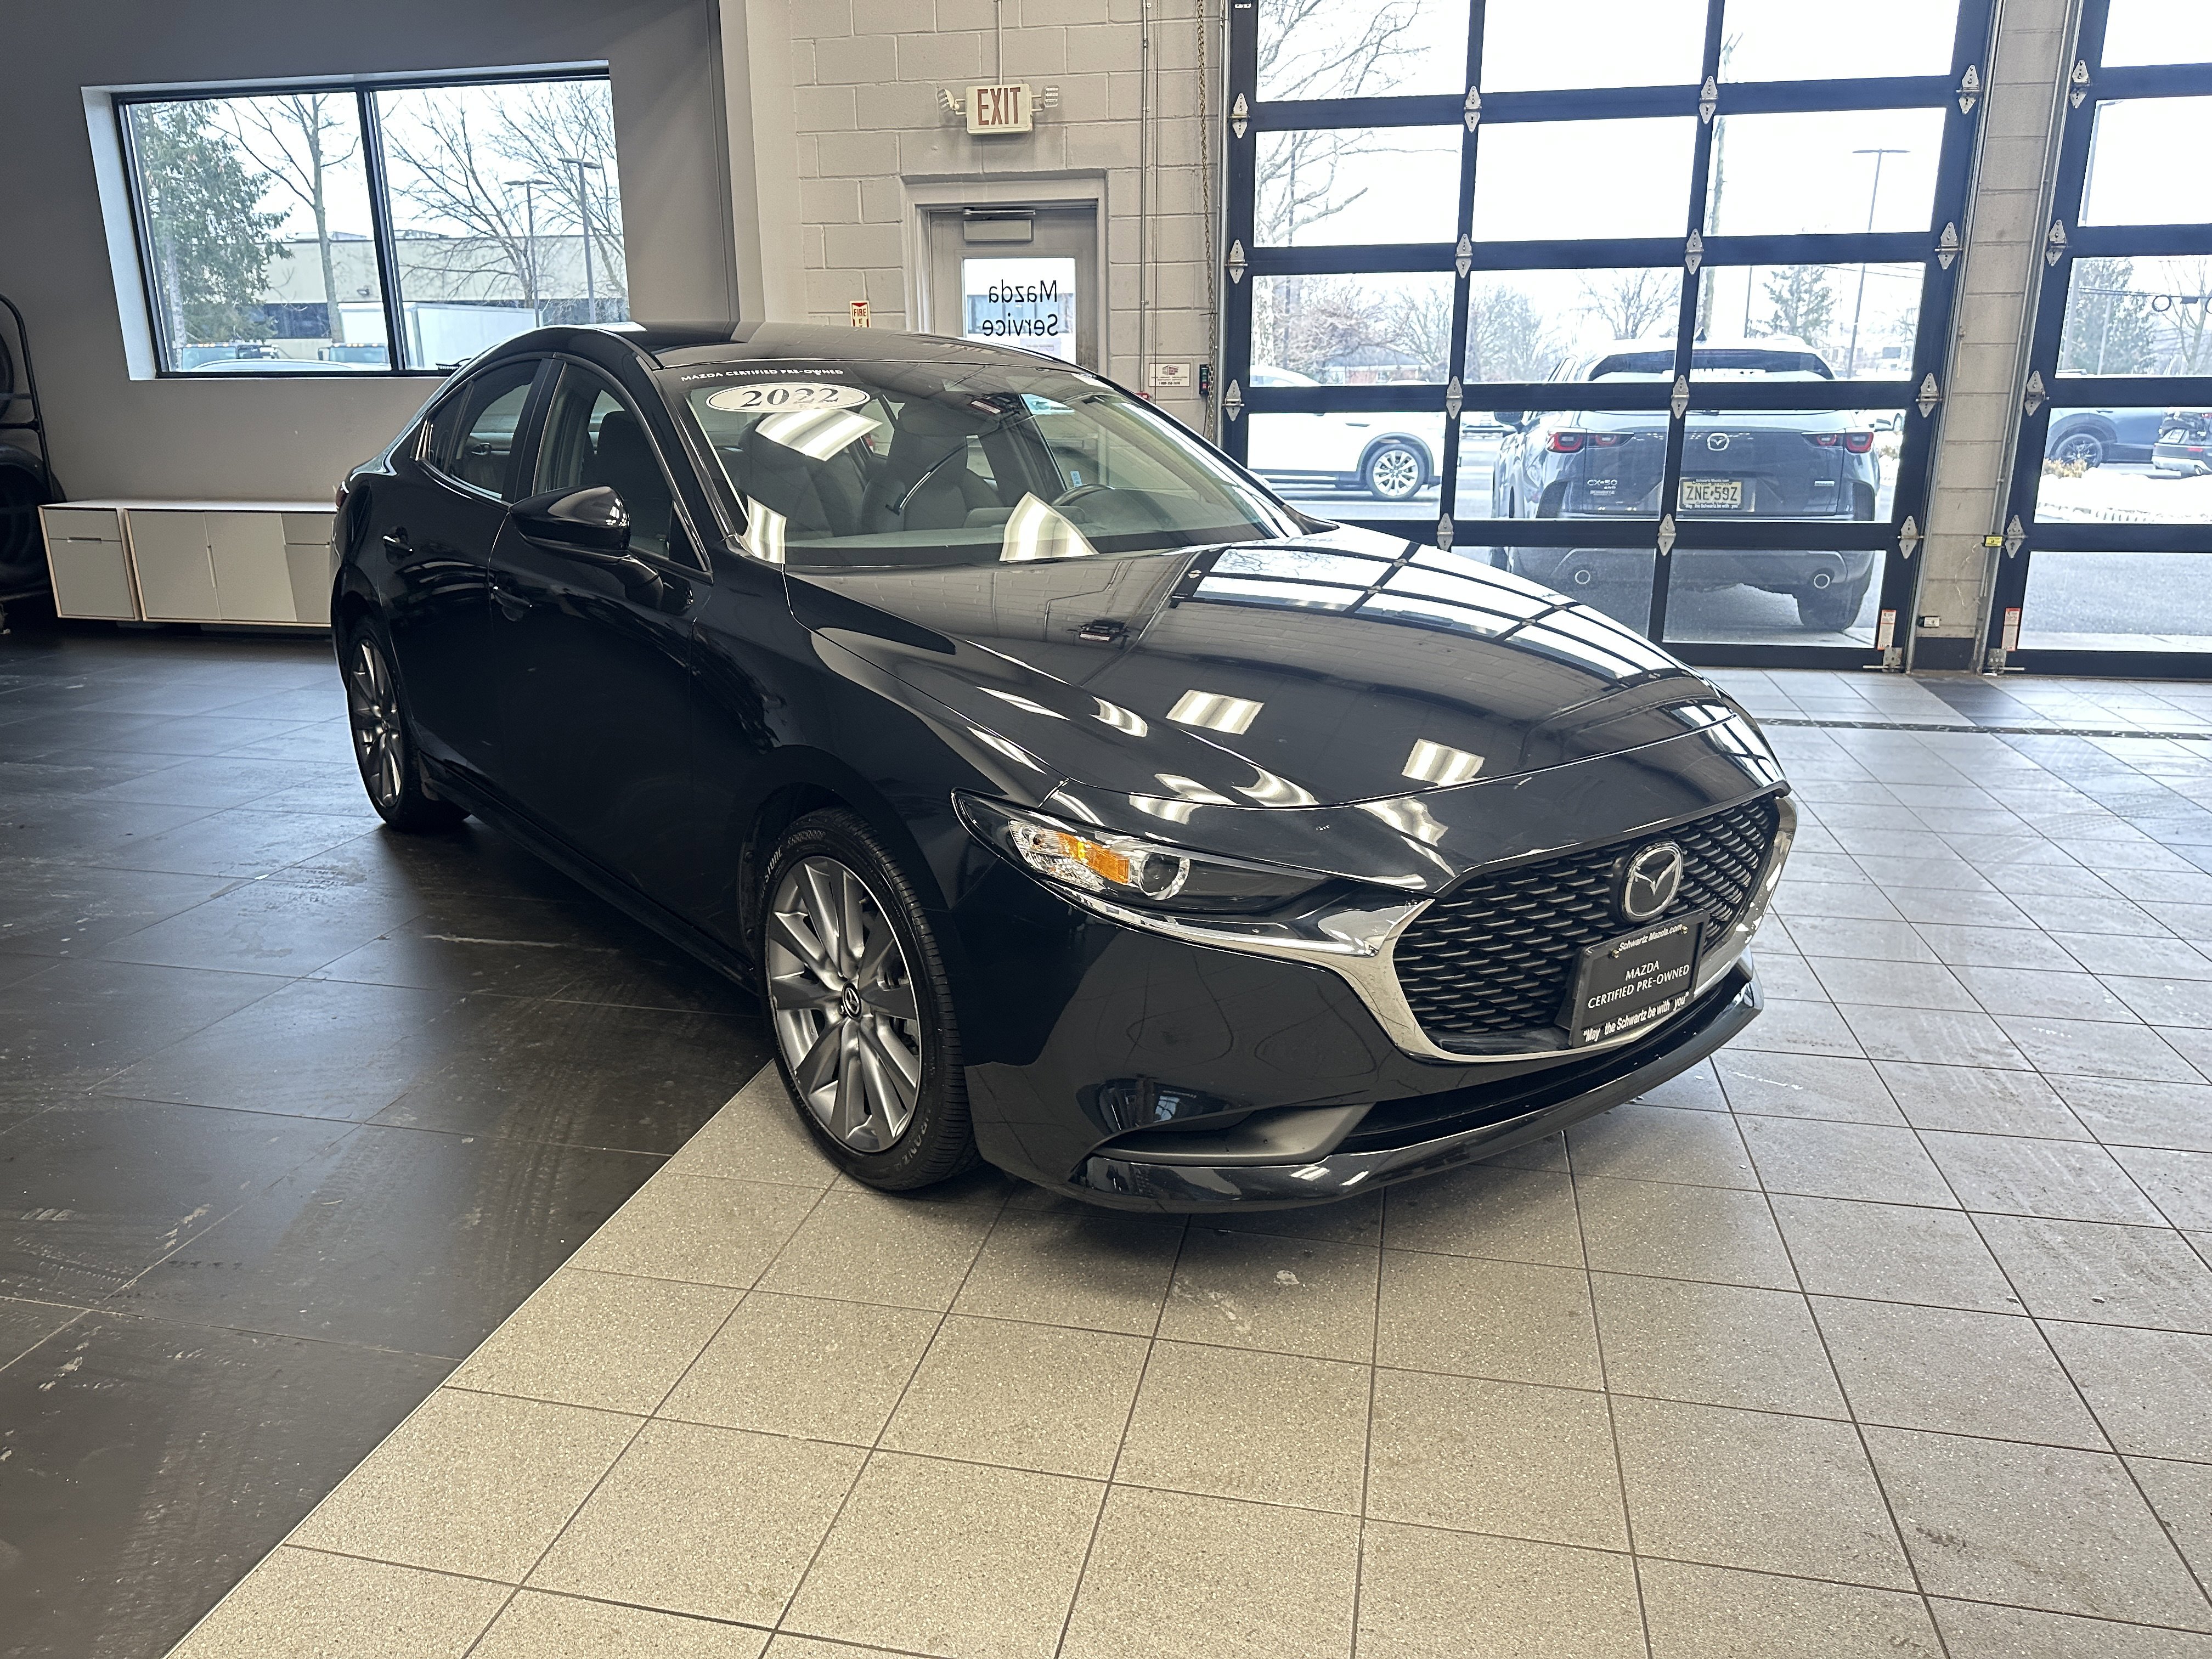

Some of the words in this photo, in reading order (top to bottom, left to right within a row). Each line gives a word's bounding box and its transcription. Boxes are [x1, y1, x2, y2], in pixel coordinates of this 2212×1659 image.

[978, 87, 1021, 125] EXIT
[854, 308, 866, 317] FIRE
[681, 372, 724, 381] MAZDA
[740, 388, 839, 408] 2022
[1626, 961, 1660, 981] MAZDA
[1588, 984, 1634, 1008] CERTIFIED
[1637, 964, 1690, 992] PRE-OWNED
[1604, 1022, 1616, 1035] the
[1616, 1009, 1648, 1031] Schwartz
[1647, 1006, 1656, 1019] be
[1657, 999, 1671, 1015] with
